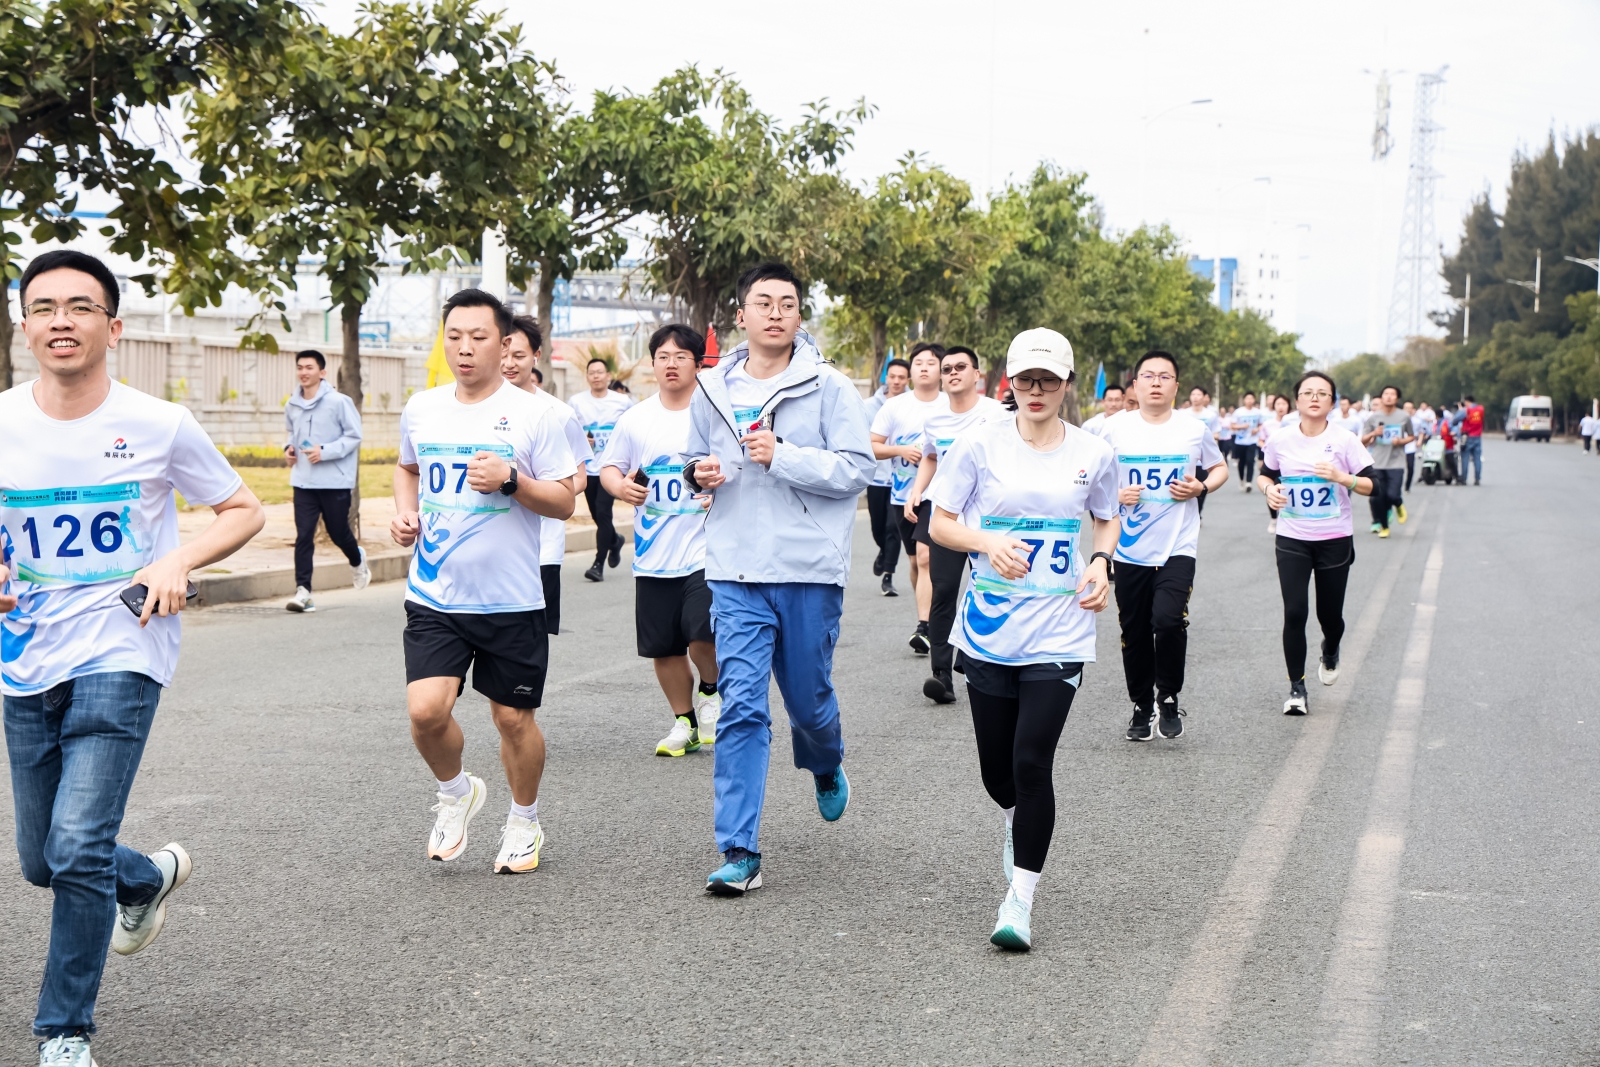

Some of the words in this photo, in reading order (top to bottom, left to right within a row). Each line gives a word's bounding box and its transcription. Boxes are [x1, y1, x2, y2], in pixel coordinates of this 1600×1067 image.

[429, 462, 491, 494] 07
[652, 479, 695, 502] 10
[1129, 468, 1180, 490] 054
[1289, 487, 1331, 507] 192
[22, 511, 122, 559] 126
[1021, 538, 1069, 574] 75
